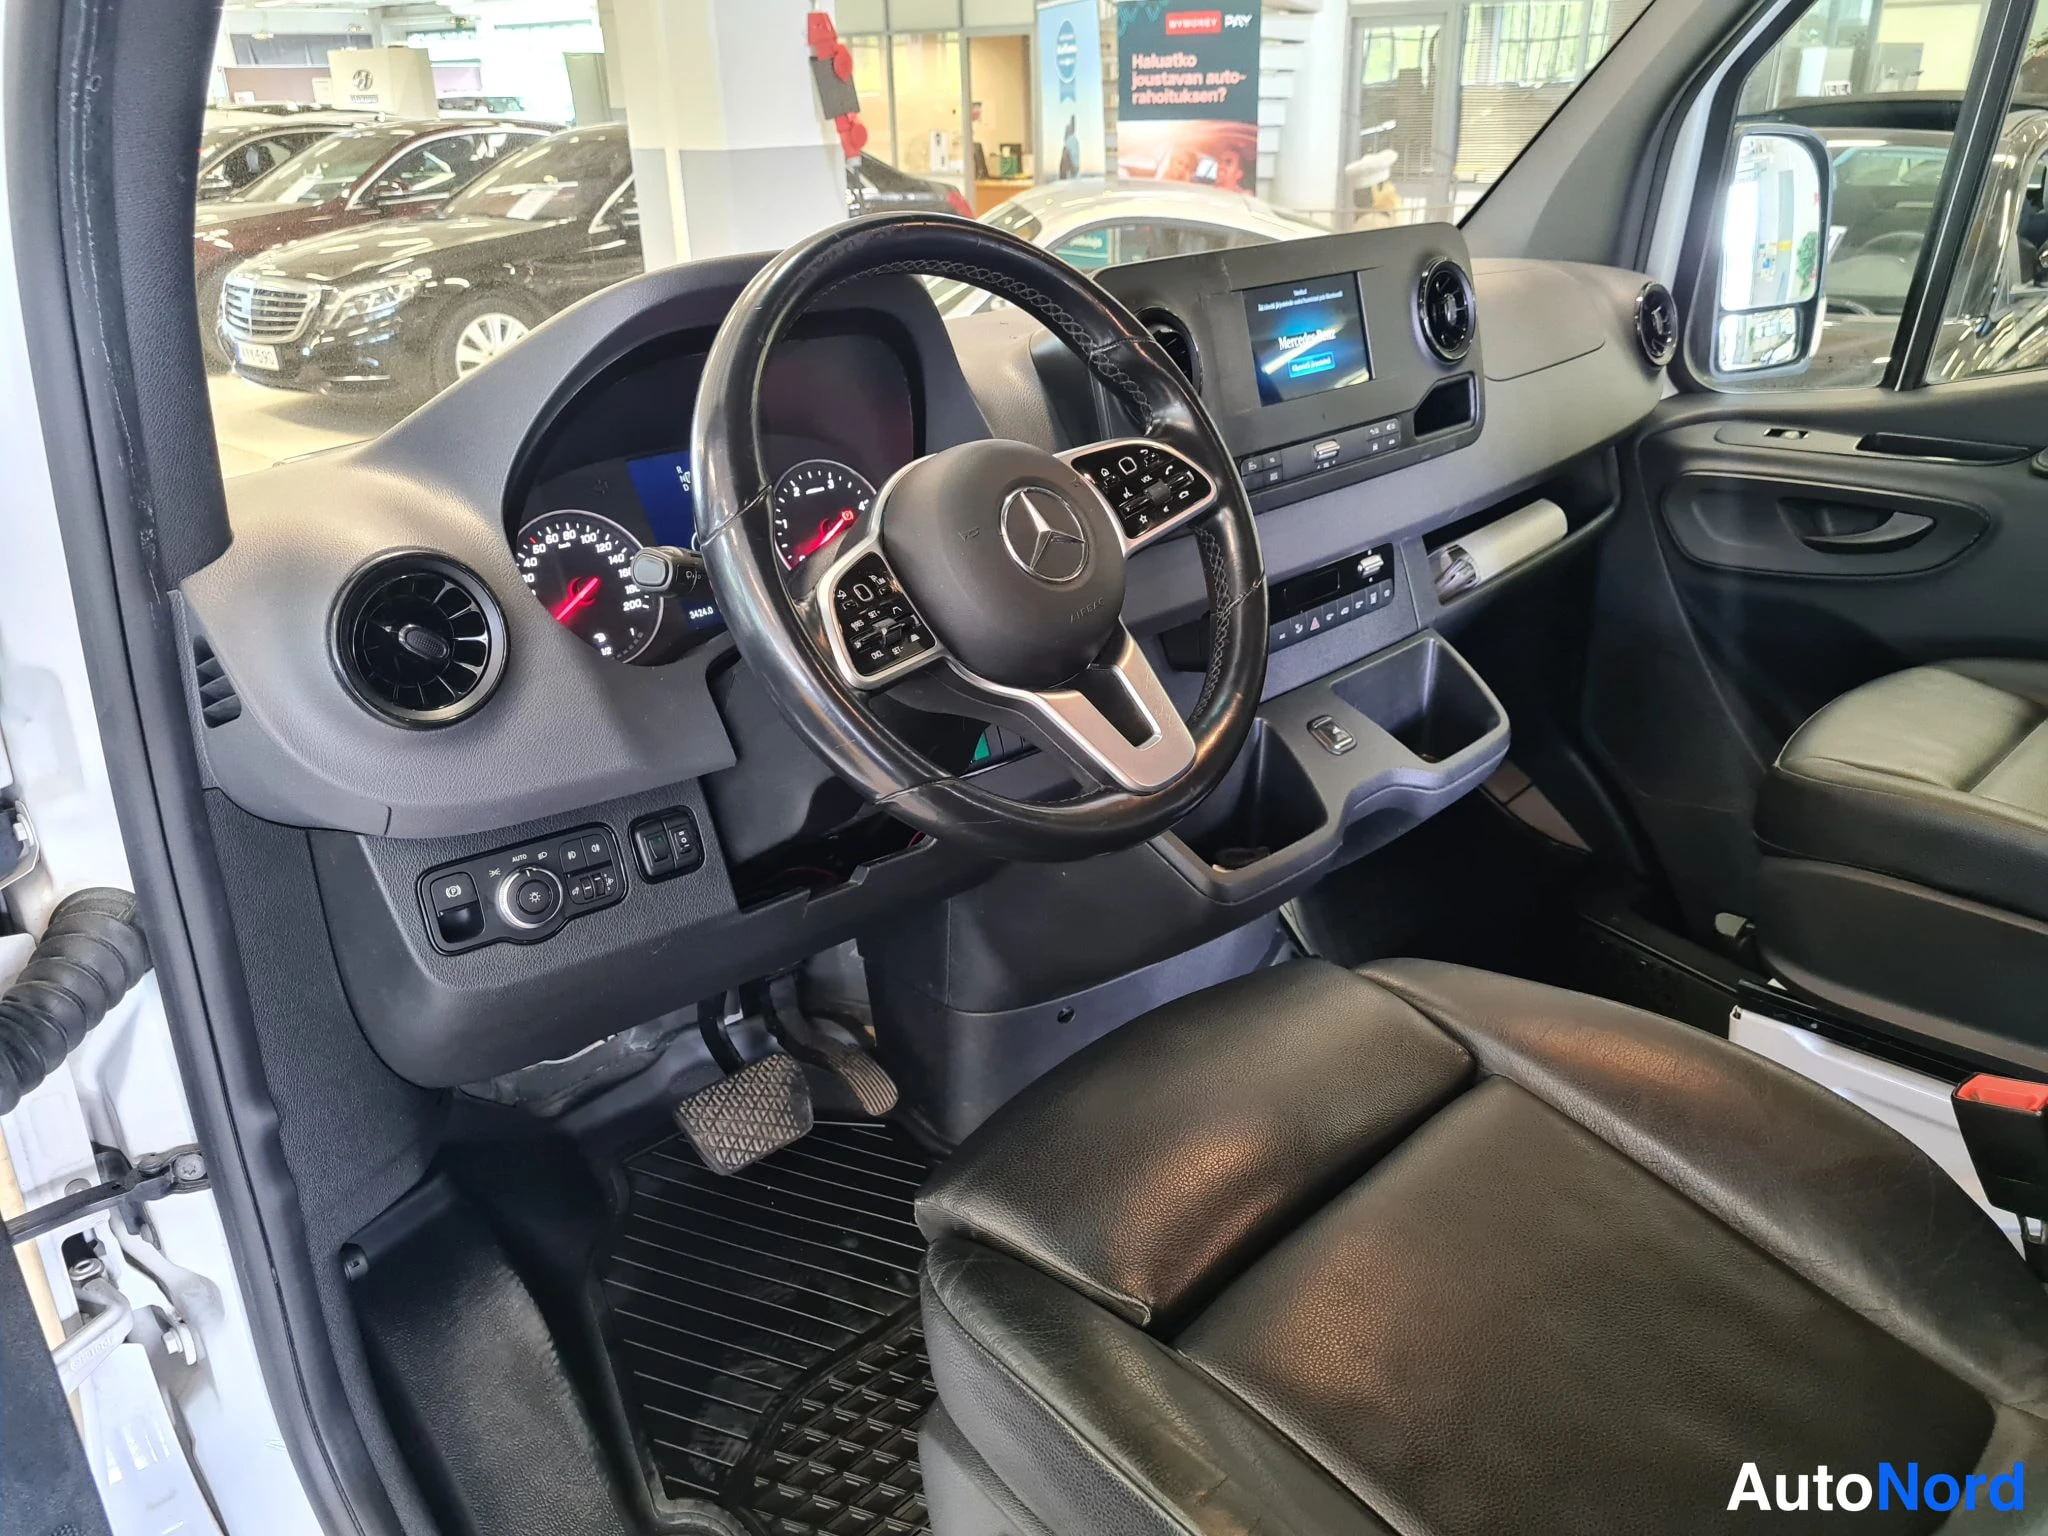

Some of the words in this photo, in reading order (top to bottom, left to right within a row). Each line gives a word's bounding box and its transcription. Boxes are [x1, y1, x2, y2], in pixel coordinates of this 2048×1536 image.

[1224, 14, 1253, 28] PAY
[1132, 52, 1197, 69] Haluatko
[1131, 71, 1203, 91] joustavan
[1206, 70, 1247, 85] auto-
[1132, 87, 1227, 104] rahoituksen?
[827, 479, 835, 489] 3
[793, 486, 801, 497] 2
[545, 533, 560, 544] 60
[562, 529, 577, 541] 80
[580, 532, 597, 544] 100
[595, 542, 612, 553] 120
[523, 557, 538, 567] 40
[608, 553, 625, 565] 140
[623, 599, 642, 611] 200
[512, 854, 527, 863] AUTO
